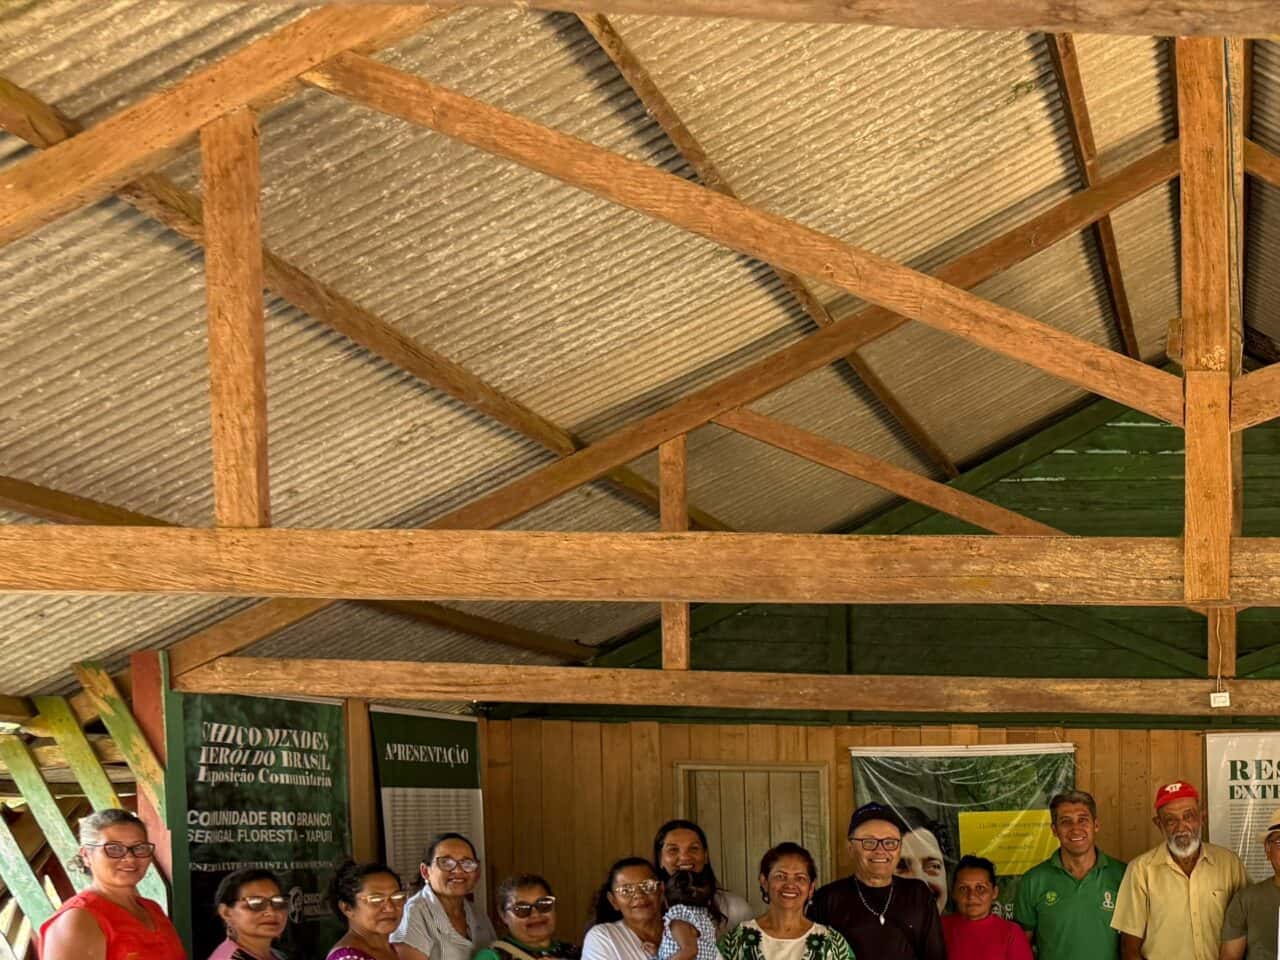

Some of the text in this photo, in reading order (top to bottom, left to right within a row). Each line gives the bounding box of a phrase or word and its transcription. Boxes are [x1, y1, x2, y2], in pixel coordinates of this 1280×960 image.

[280, 750, 330, 771] BRASIL
[271, 811, 296, 826] RIO
[237, 829, 298, 843] FLORESTA
